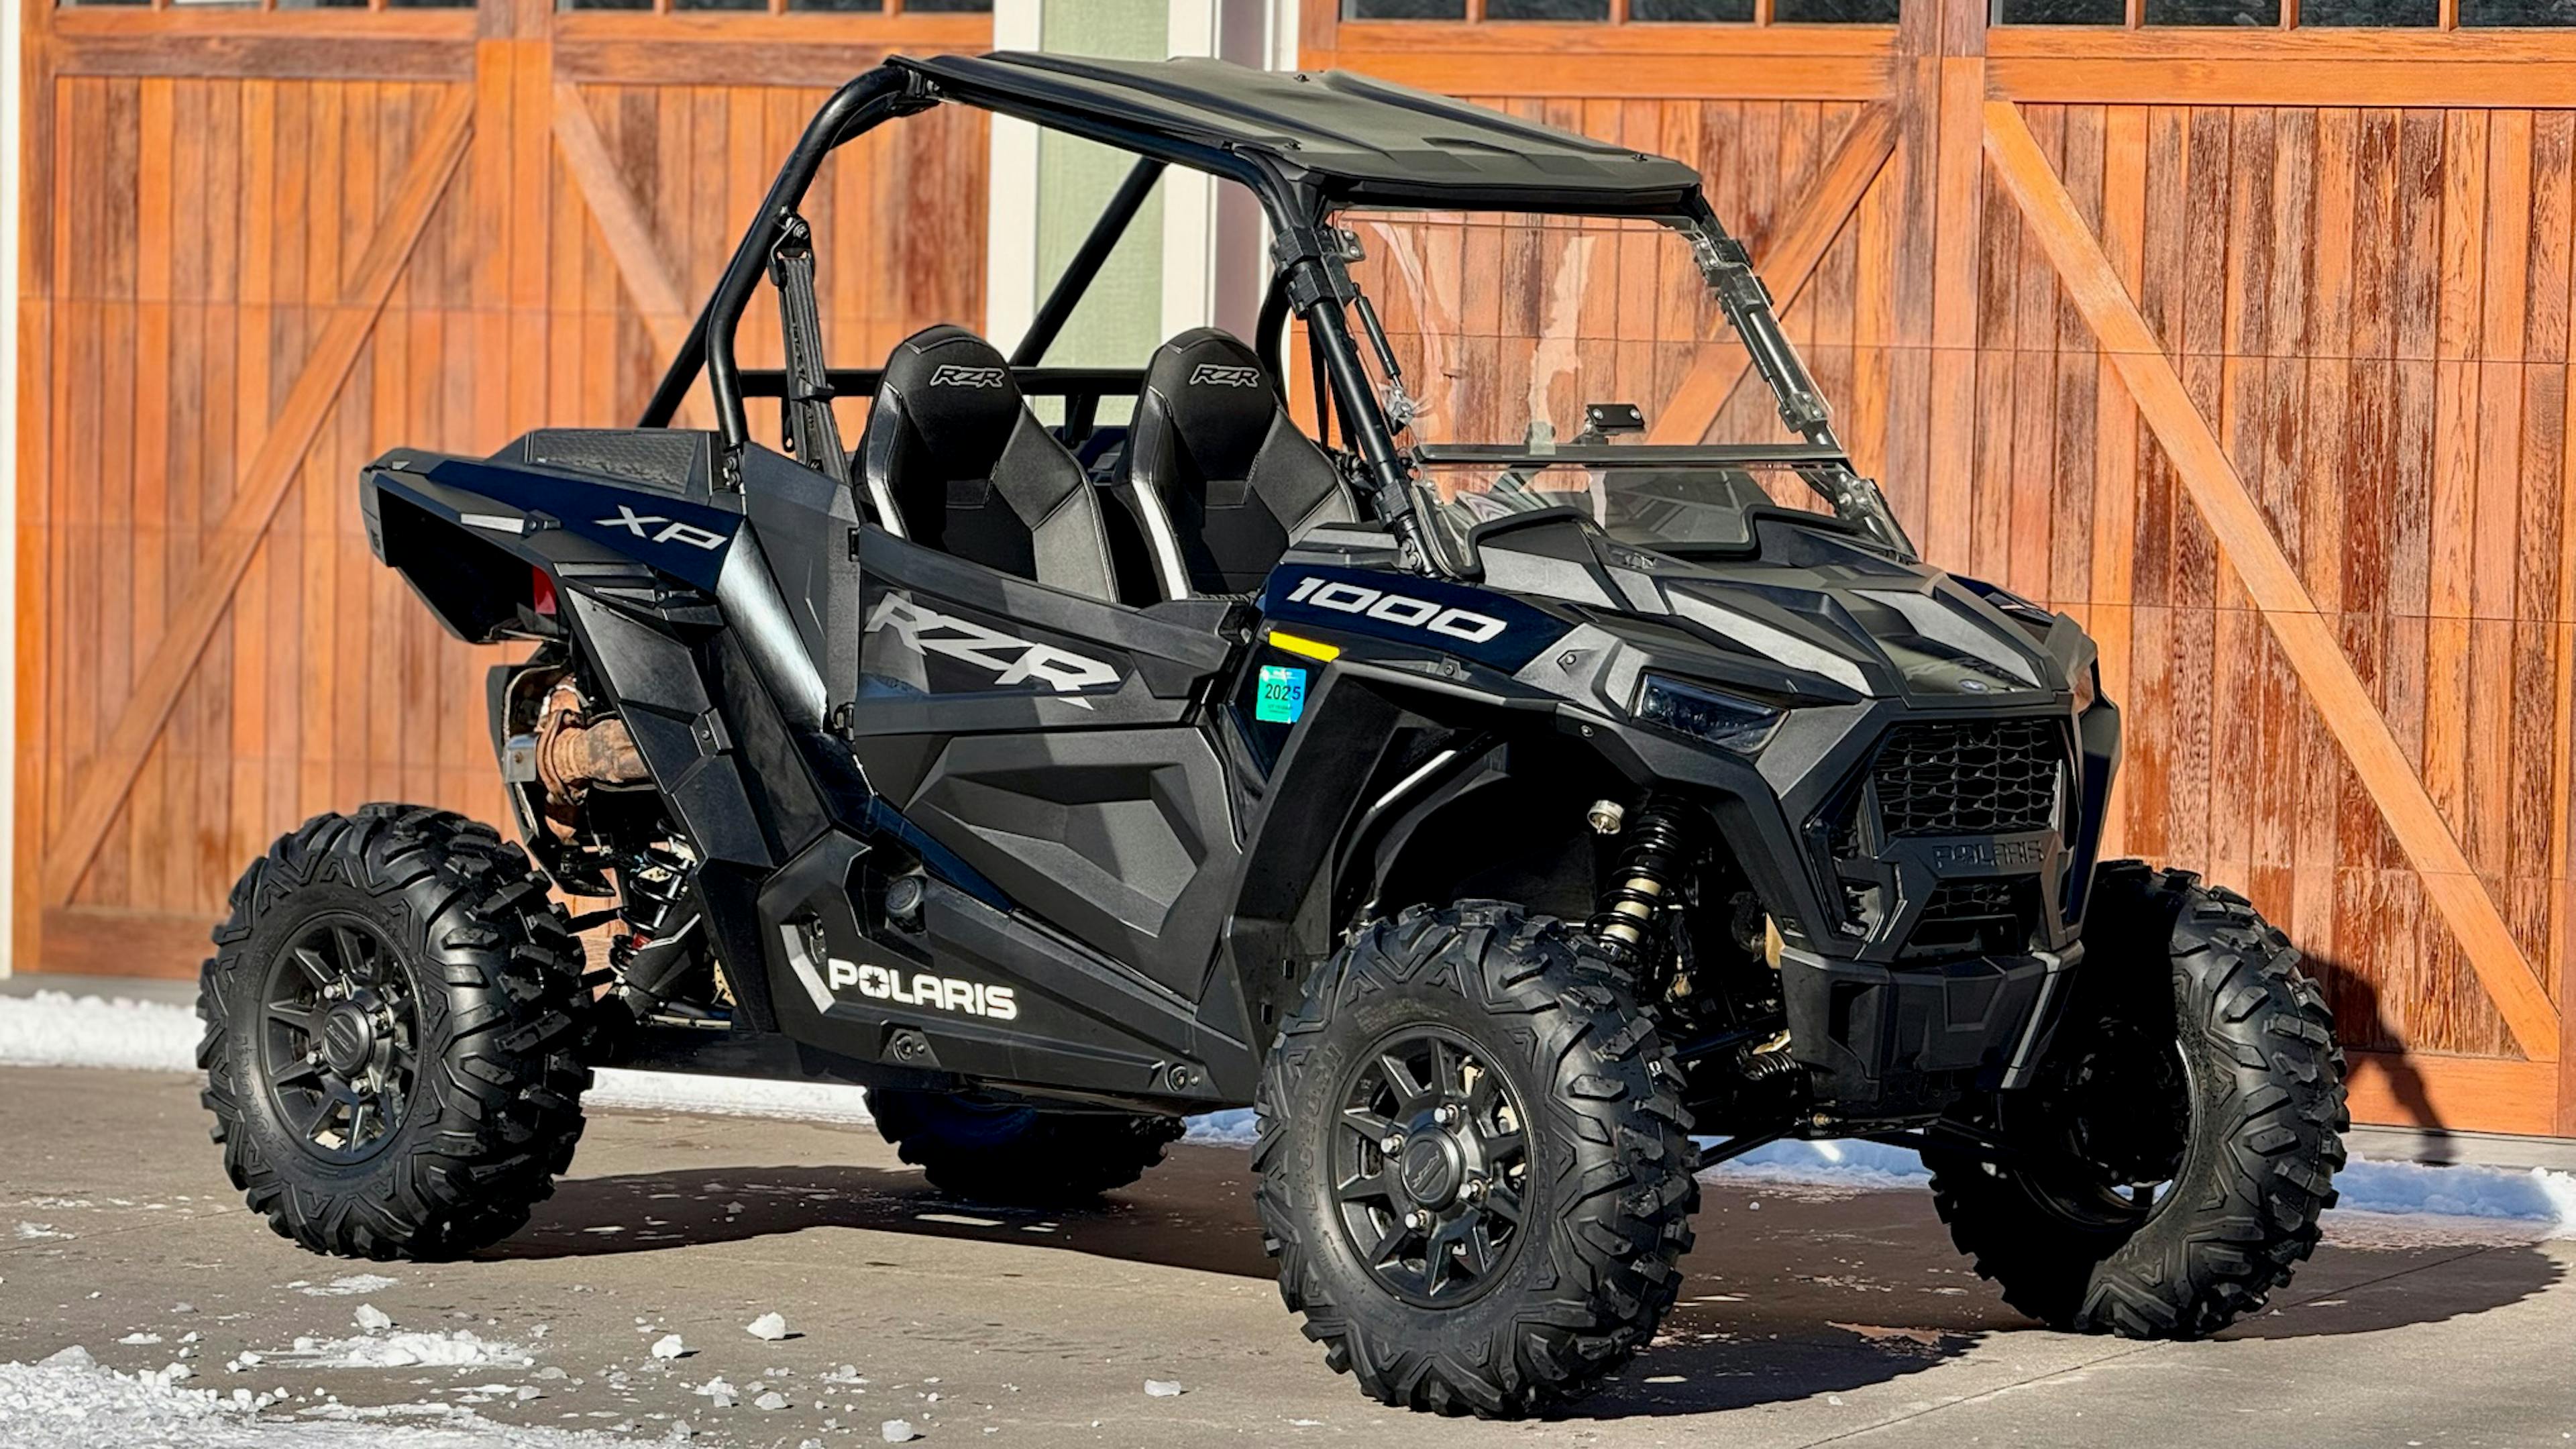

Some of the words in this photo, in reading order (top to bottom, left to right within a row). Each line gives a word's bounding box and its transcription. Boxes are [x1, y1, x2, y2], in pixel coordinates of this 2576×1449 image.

[929, 364, 1005, 388] RZR
[1189, 364, 1260, 387] RZR
[593, 504, 728, 550] XP
[1286, 576, 1507, 643] 1000
[864, 592, 1121, 710] RZR
[1265, 684, 1301, 701] 2025
[1932, 841, 2046, 869] POLARIS
[828, 958, 1018, 1020] POLARIS
[1295, 1040, 1344, 1210] BIGHORN
